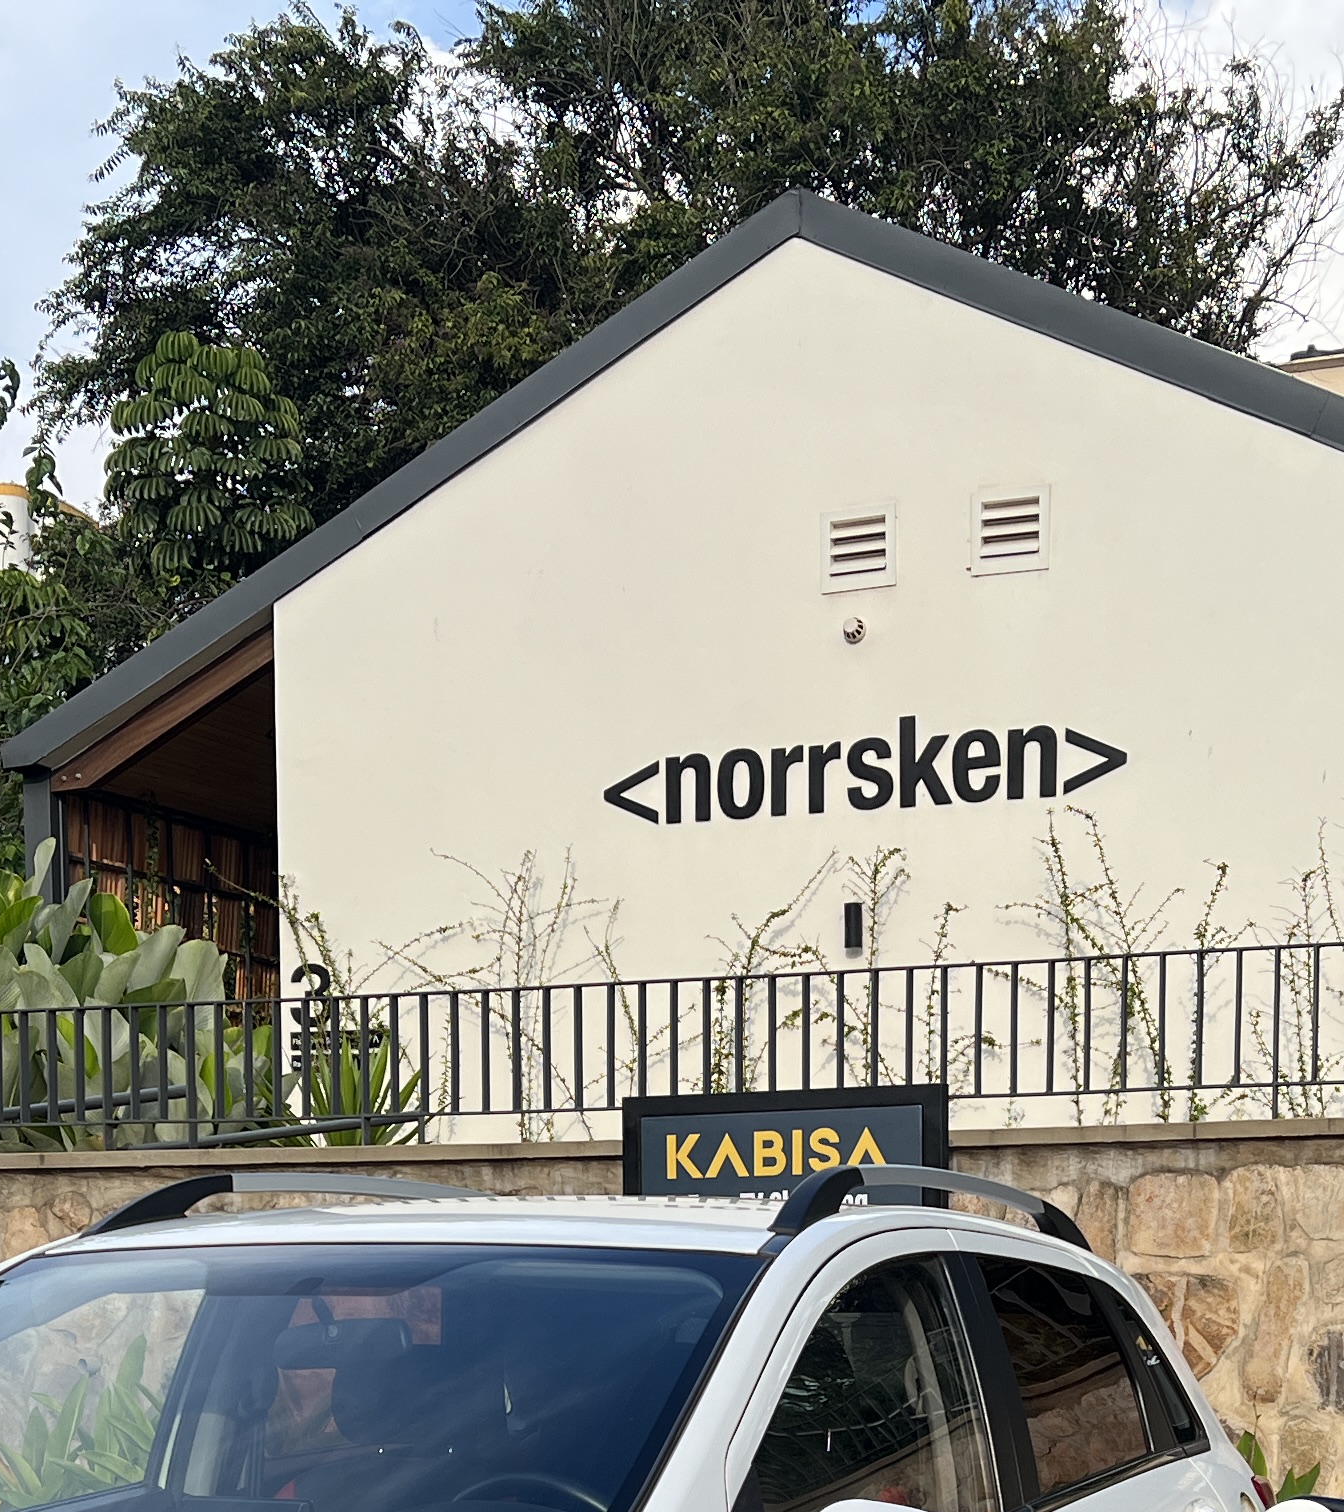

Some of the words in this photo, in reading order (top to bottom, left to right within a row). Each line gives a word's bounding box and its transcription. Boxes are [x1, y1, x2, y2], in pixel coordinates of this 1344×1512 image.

[603, 715, 1128, 825] <norrsken>
[290, 963, 331, 1028] 3
[666, 1126, 887, 1180] KABISA
